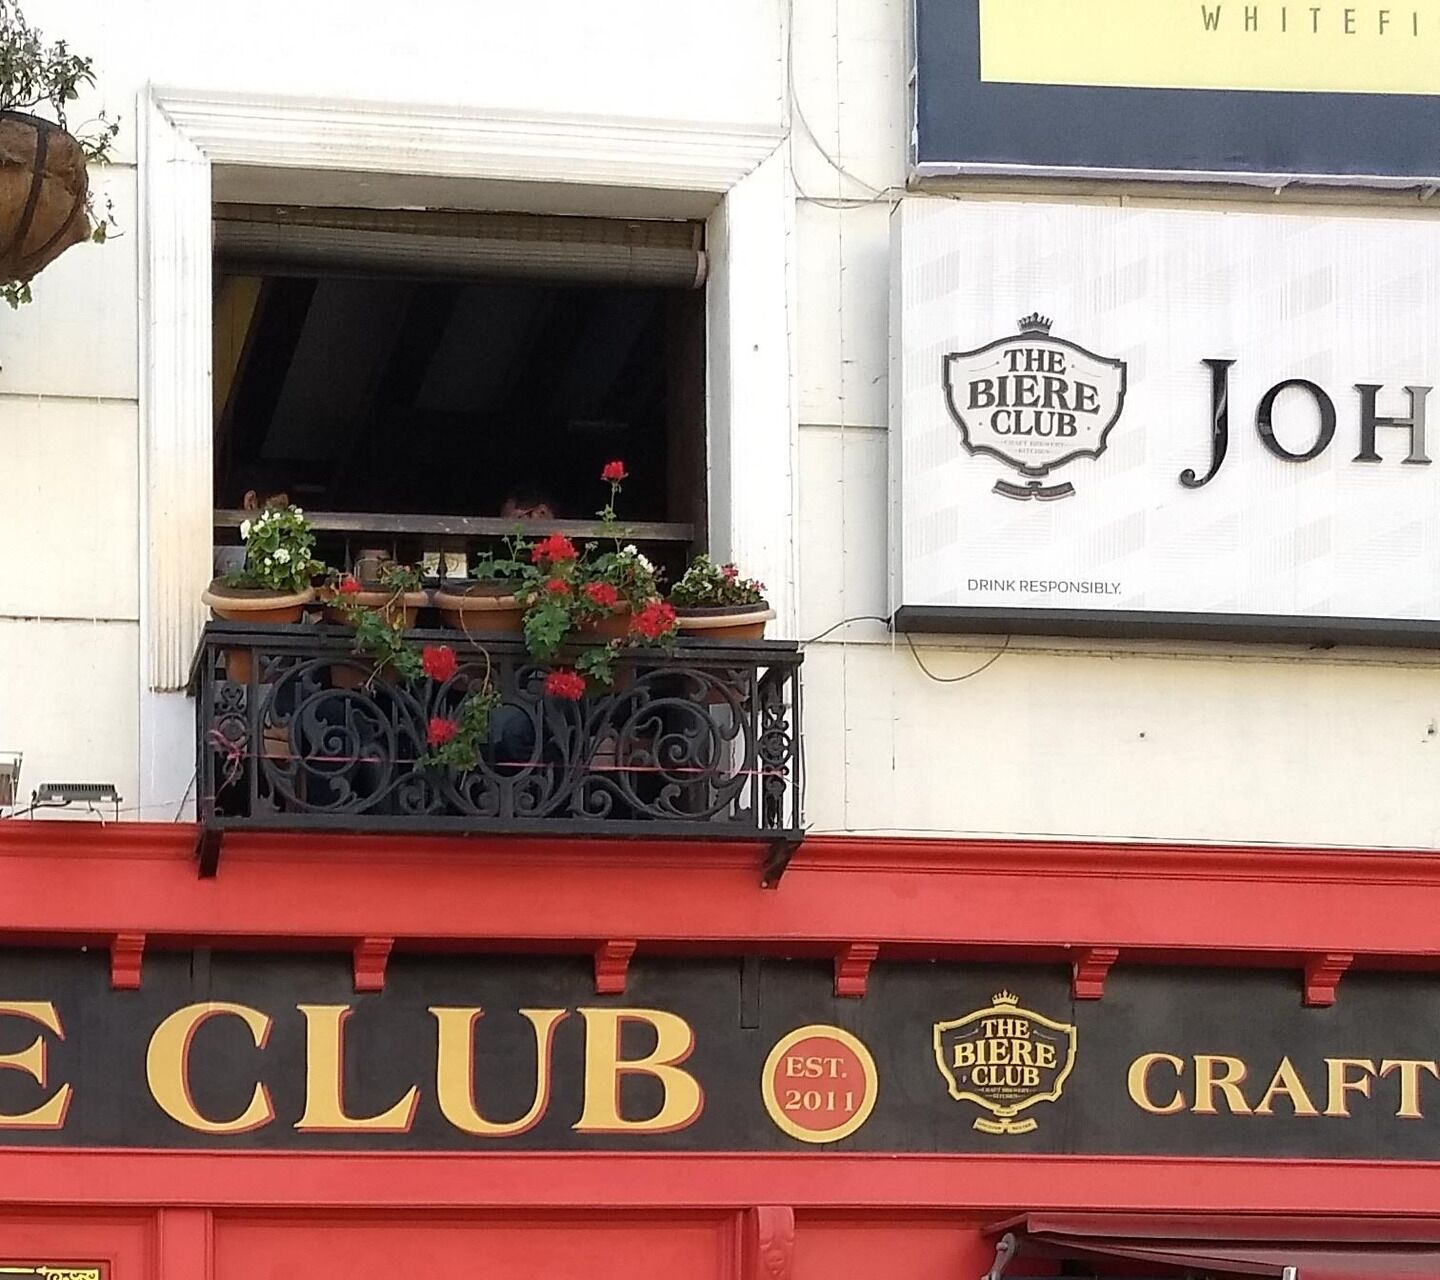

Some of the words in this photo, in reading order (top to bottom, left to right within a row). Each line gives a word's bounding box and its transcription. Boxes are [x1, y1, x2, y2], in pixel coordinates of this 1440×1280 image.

[1201, 5, 1418, 37] WHITEFI
[1003, 348, 1066, 375] THE
[967, 374, 1101, 415] BIERE
[990, 409, 1077, 437] CLUB
[1178, 358, 1434, 489] JOH
[967, 579, 1016, 591] DRINK
[1019, 580, 1122, 595] RESPONSIBLY.
[980, 1018, 1030, 1039] THE
[786, 1056, 848, 1078] EST.
[953, 1038, 1057, 1069] BIERE
[146, 1001, 704, 1137] CLUB
[971, 1065, 1040, 1087] CLUB
[1127, 1052, 1440, 1119] CRAFT
[784, 1090, 854, 1112] 2011
